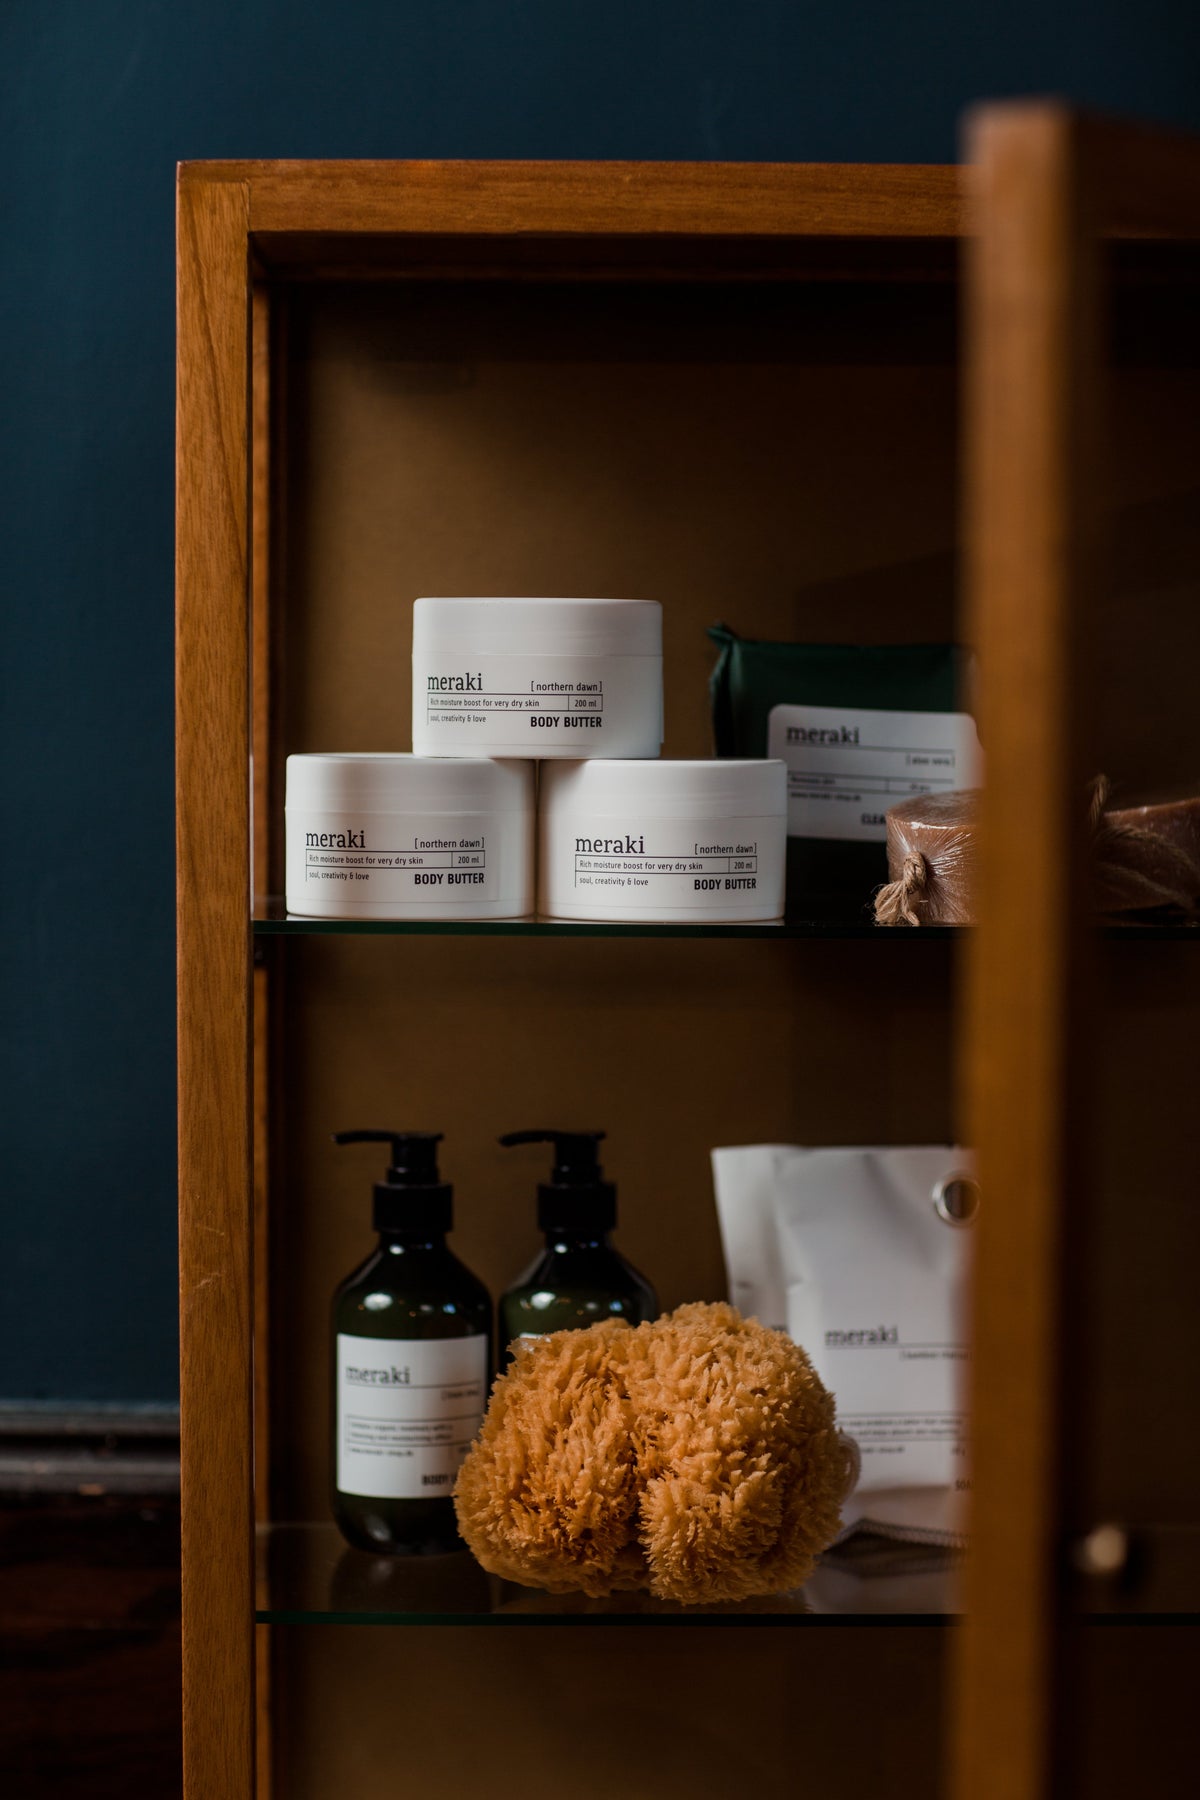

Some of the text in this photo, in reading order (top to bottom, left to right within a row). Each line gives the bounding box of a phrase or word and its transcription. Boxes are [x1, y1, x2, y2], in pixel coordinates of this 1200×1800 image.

[428, 672, 483, 691] meraki
[431, 698, 439, 706] Rich
[464, 699, 481, 707] boost
[483, 699, 492, 707] for
[495, 701, 510, 709] very
[512, 700, 523, 708] dry
[575, 699, 597, 708] 200 ml
[441, 715, 466, 723] creativity
[467, 715, 471, 723] &
[531, 717, 602, 728] BODY BUTTER
[787, 726, 860, 744] meraki
[306, 830, 365, 848] meraki
[575, 836, 645, 854] meraki
[310, 855, 319, 863] Rich
[320, 856, 344, 864] moisture
[395, 857, 407, 866] dry
[458, 856, 480, 864] 200 ml
[623, 862, 643, 870] boost
[645, 862, 655, 870] for
[675, 863, 687, 871] dry
[735, 862, 745, 870] 200
[309, 872, 320, 880] soul,
[322, 872, 348, 880] creativity
[415, 873, 485, 885] BODY BUTTER
[580, 877, 593, 885] soul,
[595, 878, 625, 886] creativity
[695, 878, 757, 890] BODY BUTTER
[825, 1325, 899, 1346] meraki
[346, 1366, 410, 1384] meraki
